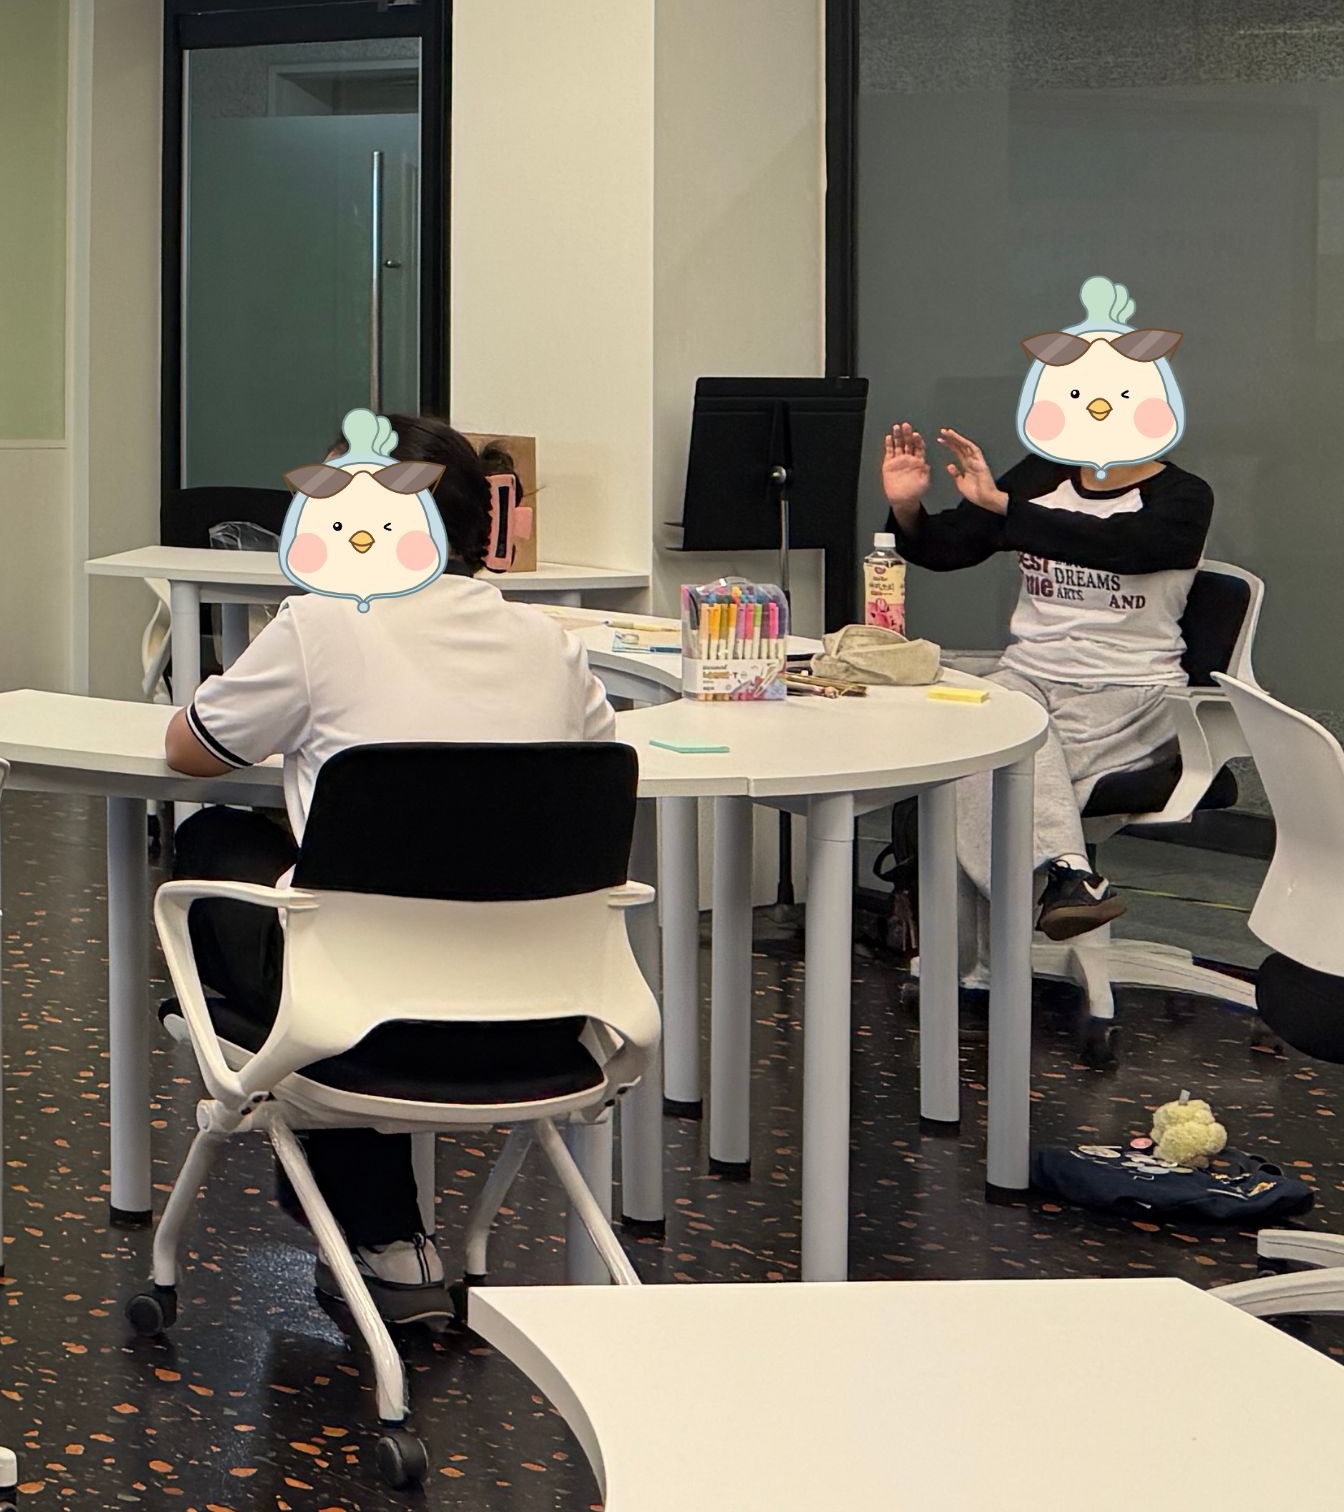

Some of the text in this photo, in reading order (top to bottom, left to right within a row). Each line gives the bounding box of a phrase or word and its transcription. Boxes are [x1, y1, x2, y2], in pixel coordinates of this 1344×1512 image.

[1054, 567, 1121, 592] DREAMS
[1056, 587, 1085, 602] ARTS
[1108, 593, 1146, 610] AND
